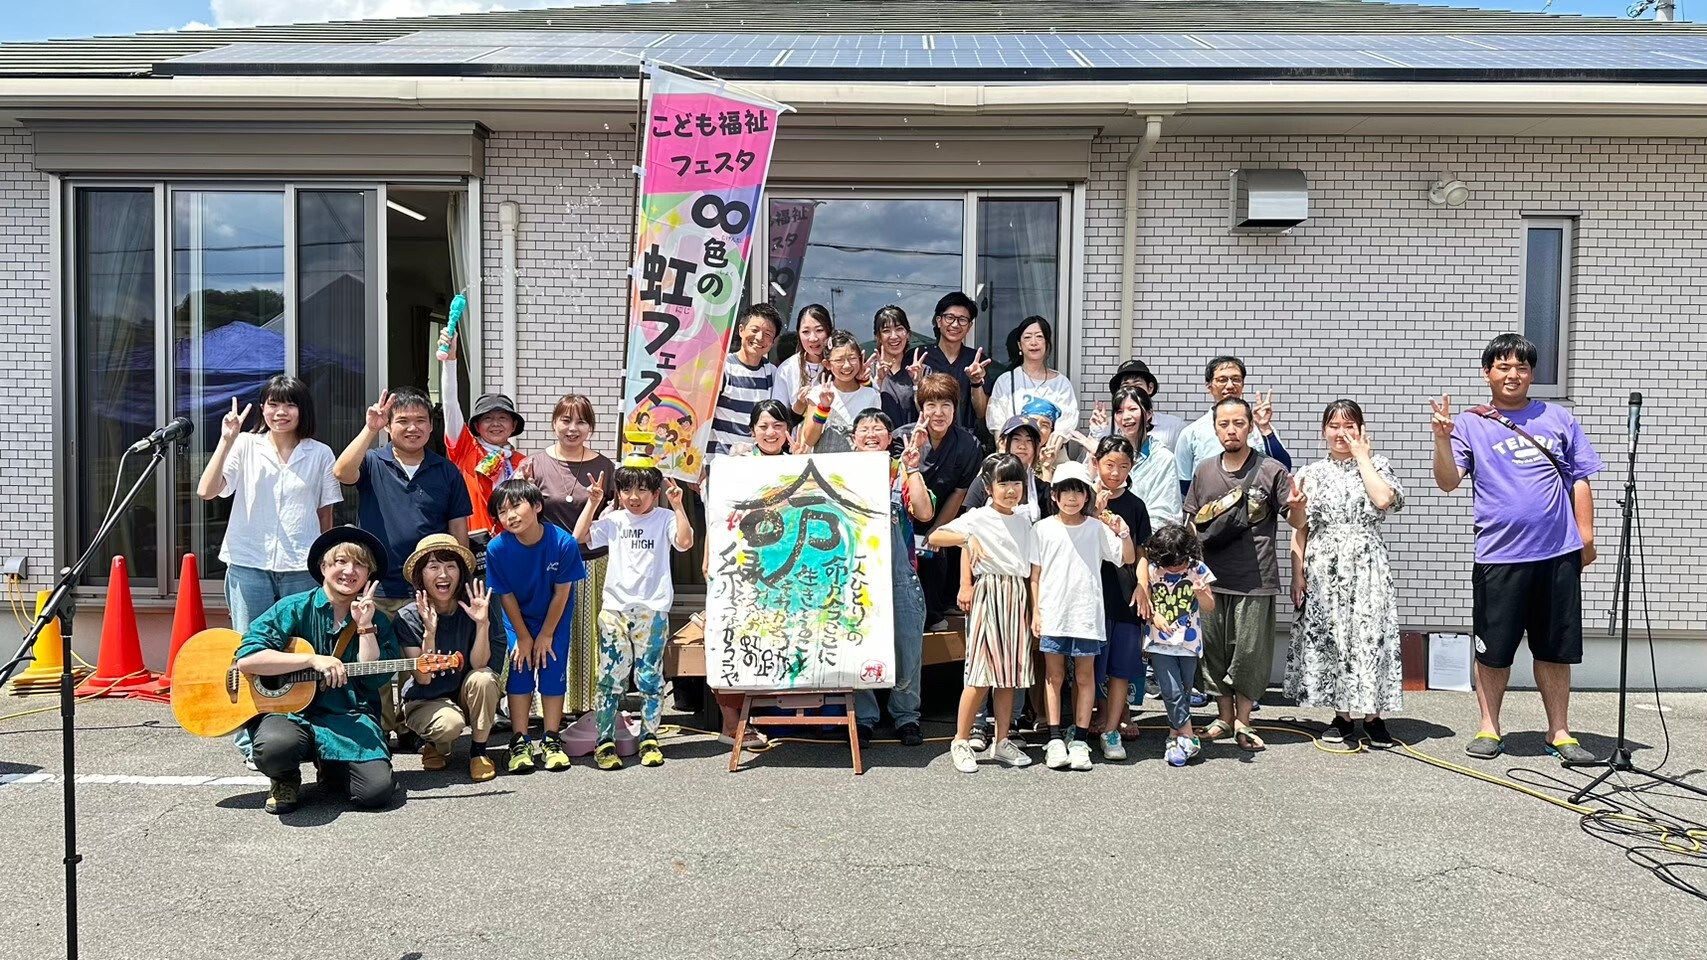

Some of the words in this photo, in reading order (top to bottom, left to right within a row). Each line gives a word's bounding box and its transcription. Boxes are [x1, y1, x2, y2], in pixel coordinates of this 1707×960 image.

[652, 109, 769, 138] こども福祉
[670, 149, 755, 177] フェスタ
[634, 243, 698, 407] 虹フェス
[1491, 435, 1554, 455] TENRI
[620, 528, 644, 539] JUMP
[631, 539, 655, 550] HIGH
[846, 554, 869, 646] 一人ひとりの
